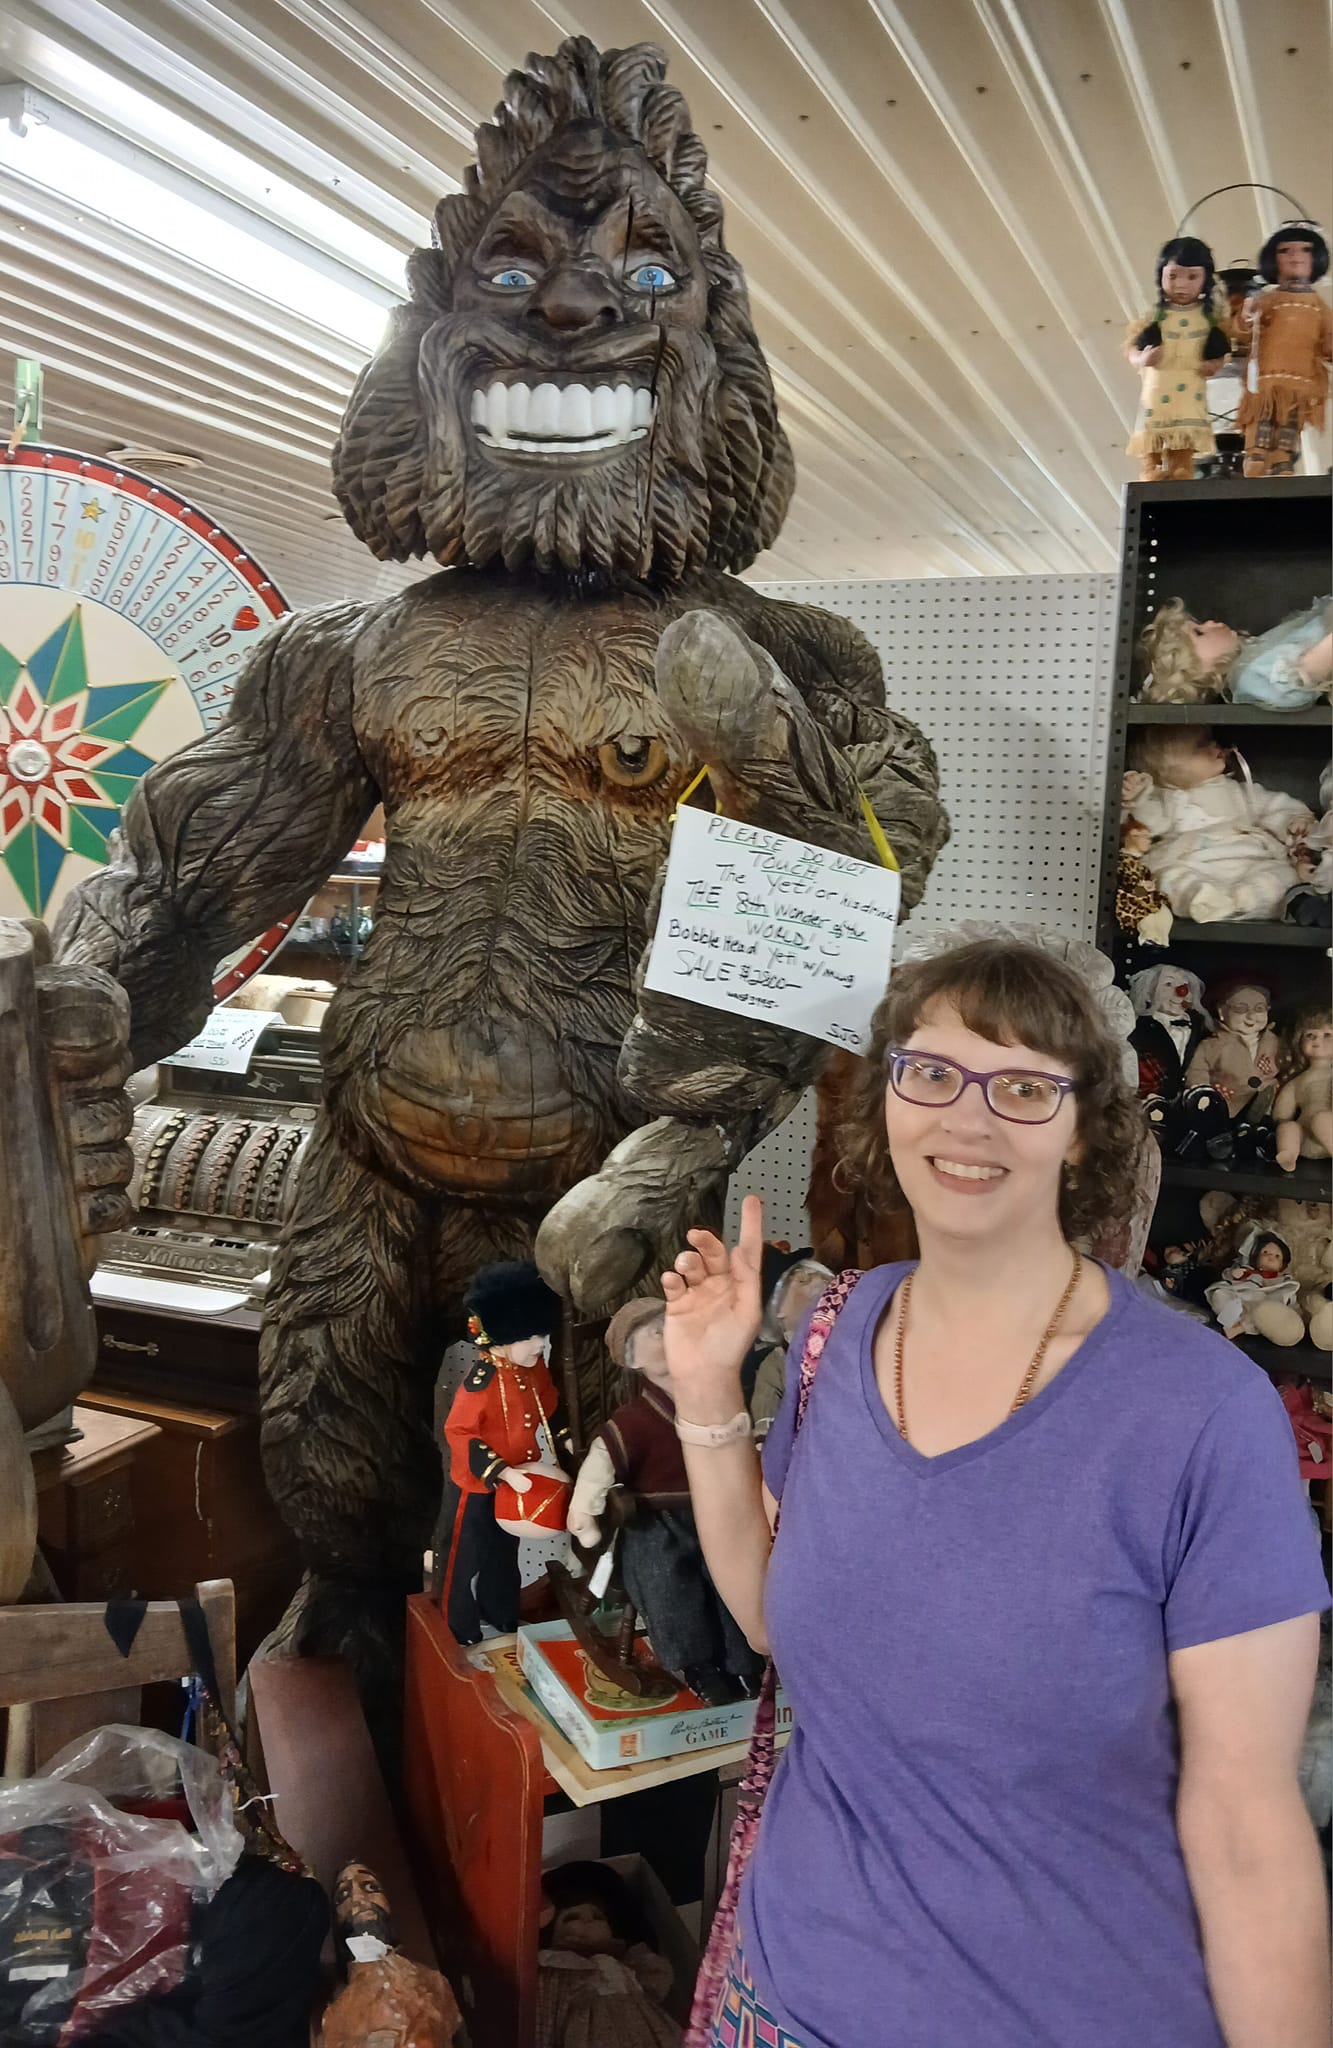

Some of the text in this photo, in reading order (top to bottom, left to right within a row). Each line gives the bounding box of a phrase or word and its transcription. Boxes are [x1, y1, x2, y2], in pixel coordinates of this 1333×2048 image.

[20, 476, 34, 577] 2 2 2 7 7
[119, 501, 134, 521] 5
[47, 480, 70, 581] 7 7 7 9 9
[105, 540, 118, 557] 5
[112, 521, 126, 540] 5
[110, 519, 160, 605] 1 1 8 8 8
[129, 536, 191, 617] 2 2 2 3 3
[147, 561, 218, 632] 4 4 4 9 9
[162, 580, 239, 648] 2 2 8 8 8
[205, 624, 232, 648] 10
[178, 648, 199, 663] 1
[708, 818, 877, 876] PLEASE DO NOT
[749, 850, 819, 881] TOUCH
[716, 863, 745, 884] The
[767, 873, 816, 896] Yeti
[815, 887, 838, 900] or
[686, 880, 722, 905] THE
[736, 891, 767, 913] 8th
[774, 901, 831, 926] Wonder
[674, 950, 737, 982] SALE
[686, 1727, 728, 1745] GAME
